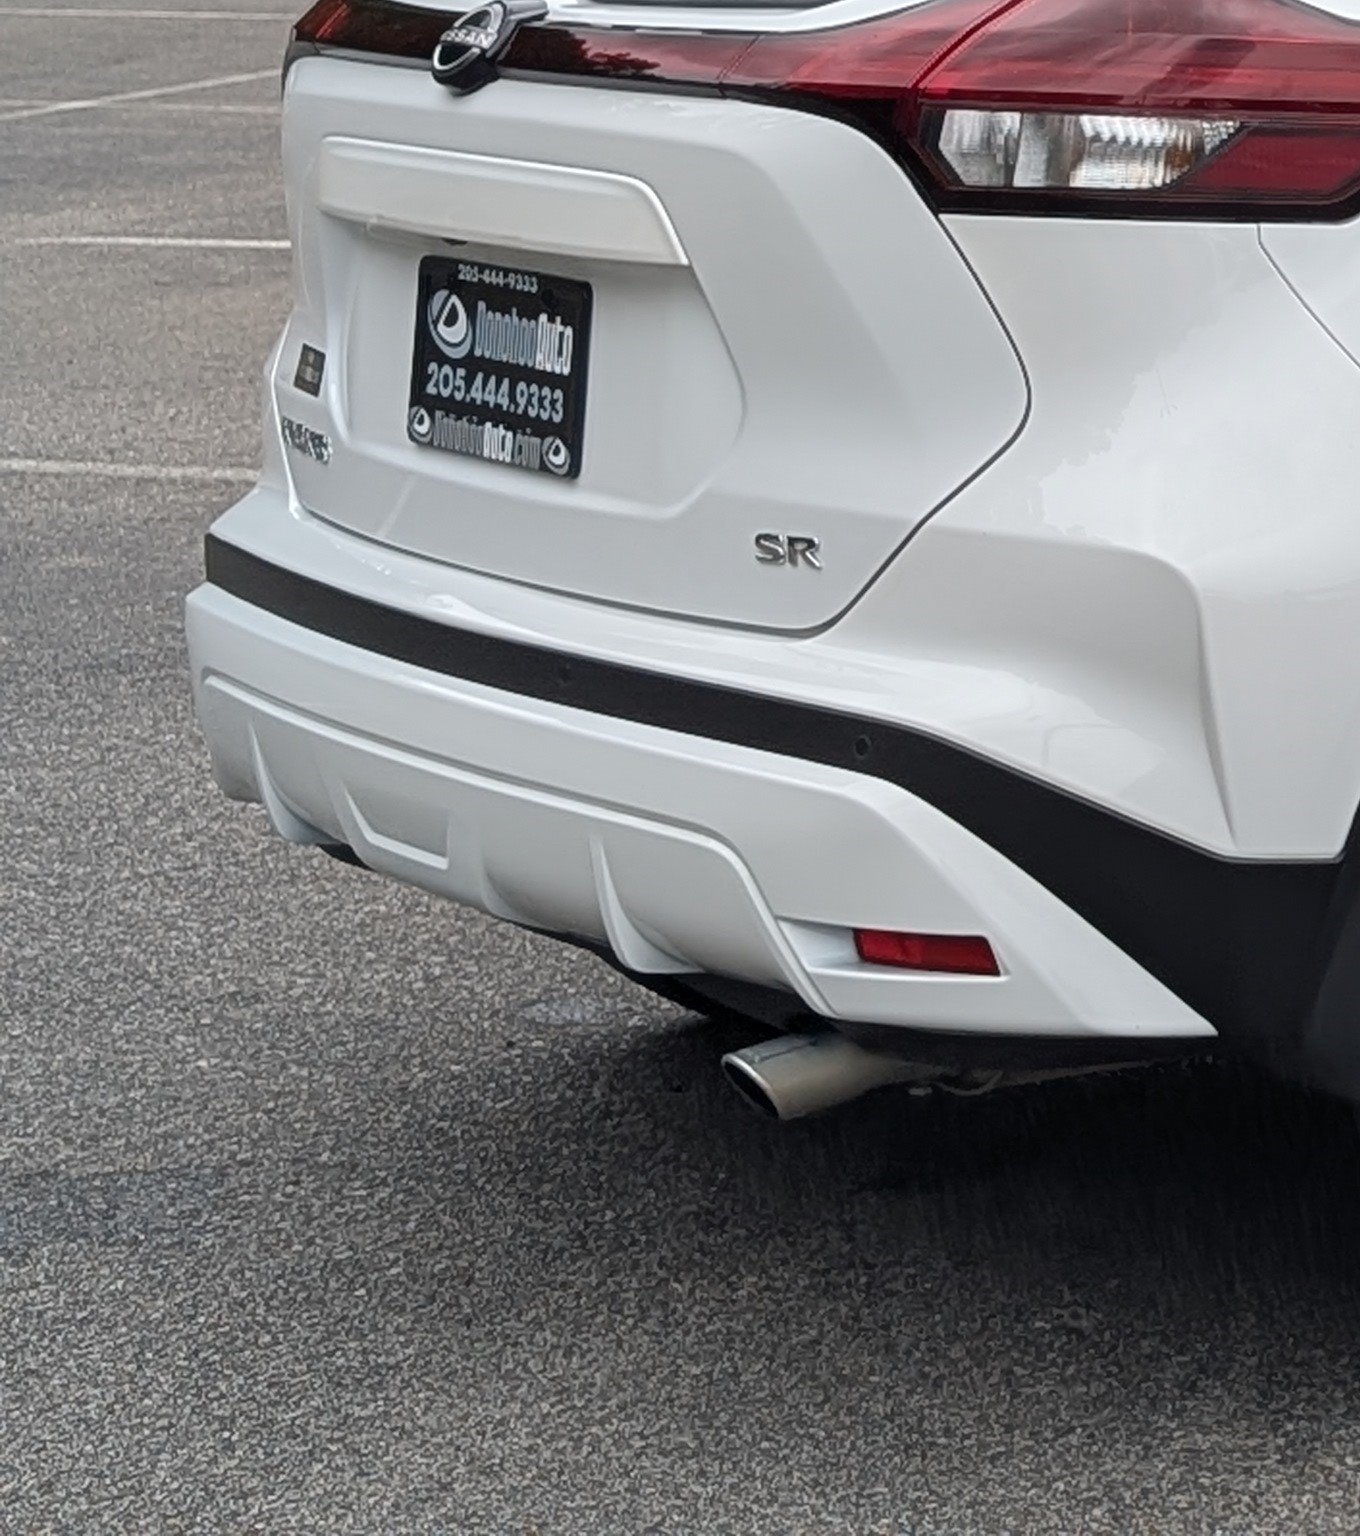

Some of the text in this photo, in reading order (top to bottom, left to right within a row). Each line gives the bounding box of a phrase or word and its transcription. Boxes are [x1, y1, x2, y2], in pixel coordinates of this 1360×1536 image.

[457, 263, 540, 294] 205-444-9333
[474, 300, 574, 377] DonohooAuto
[425, 362, 565, 424] 205.444.9333
[754, 532, 822, 570] SR
